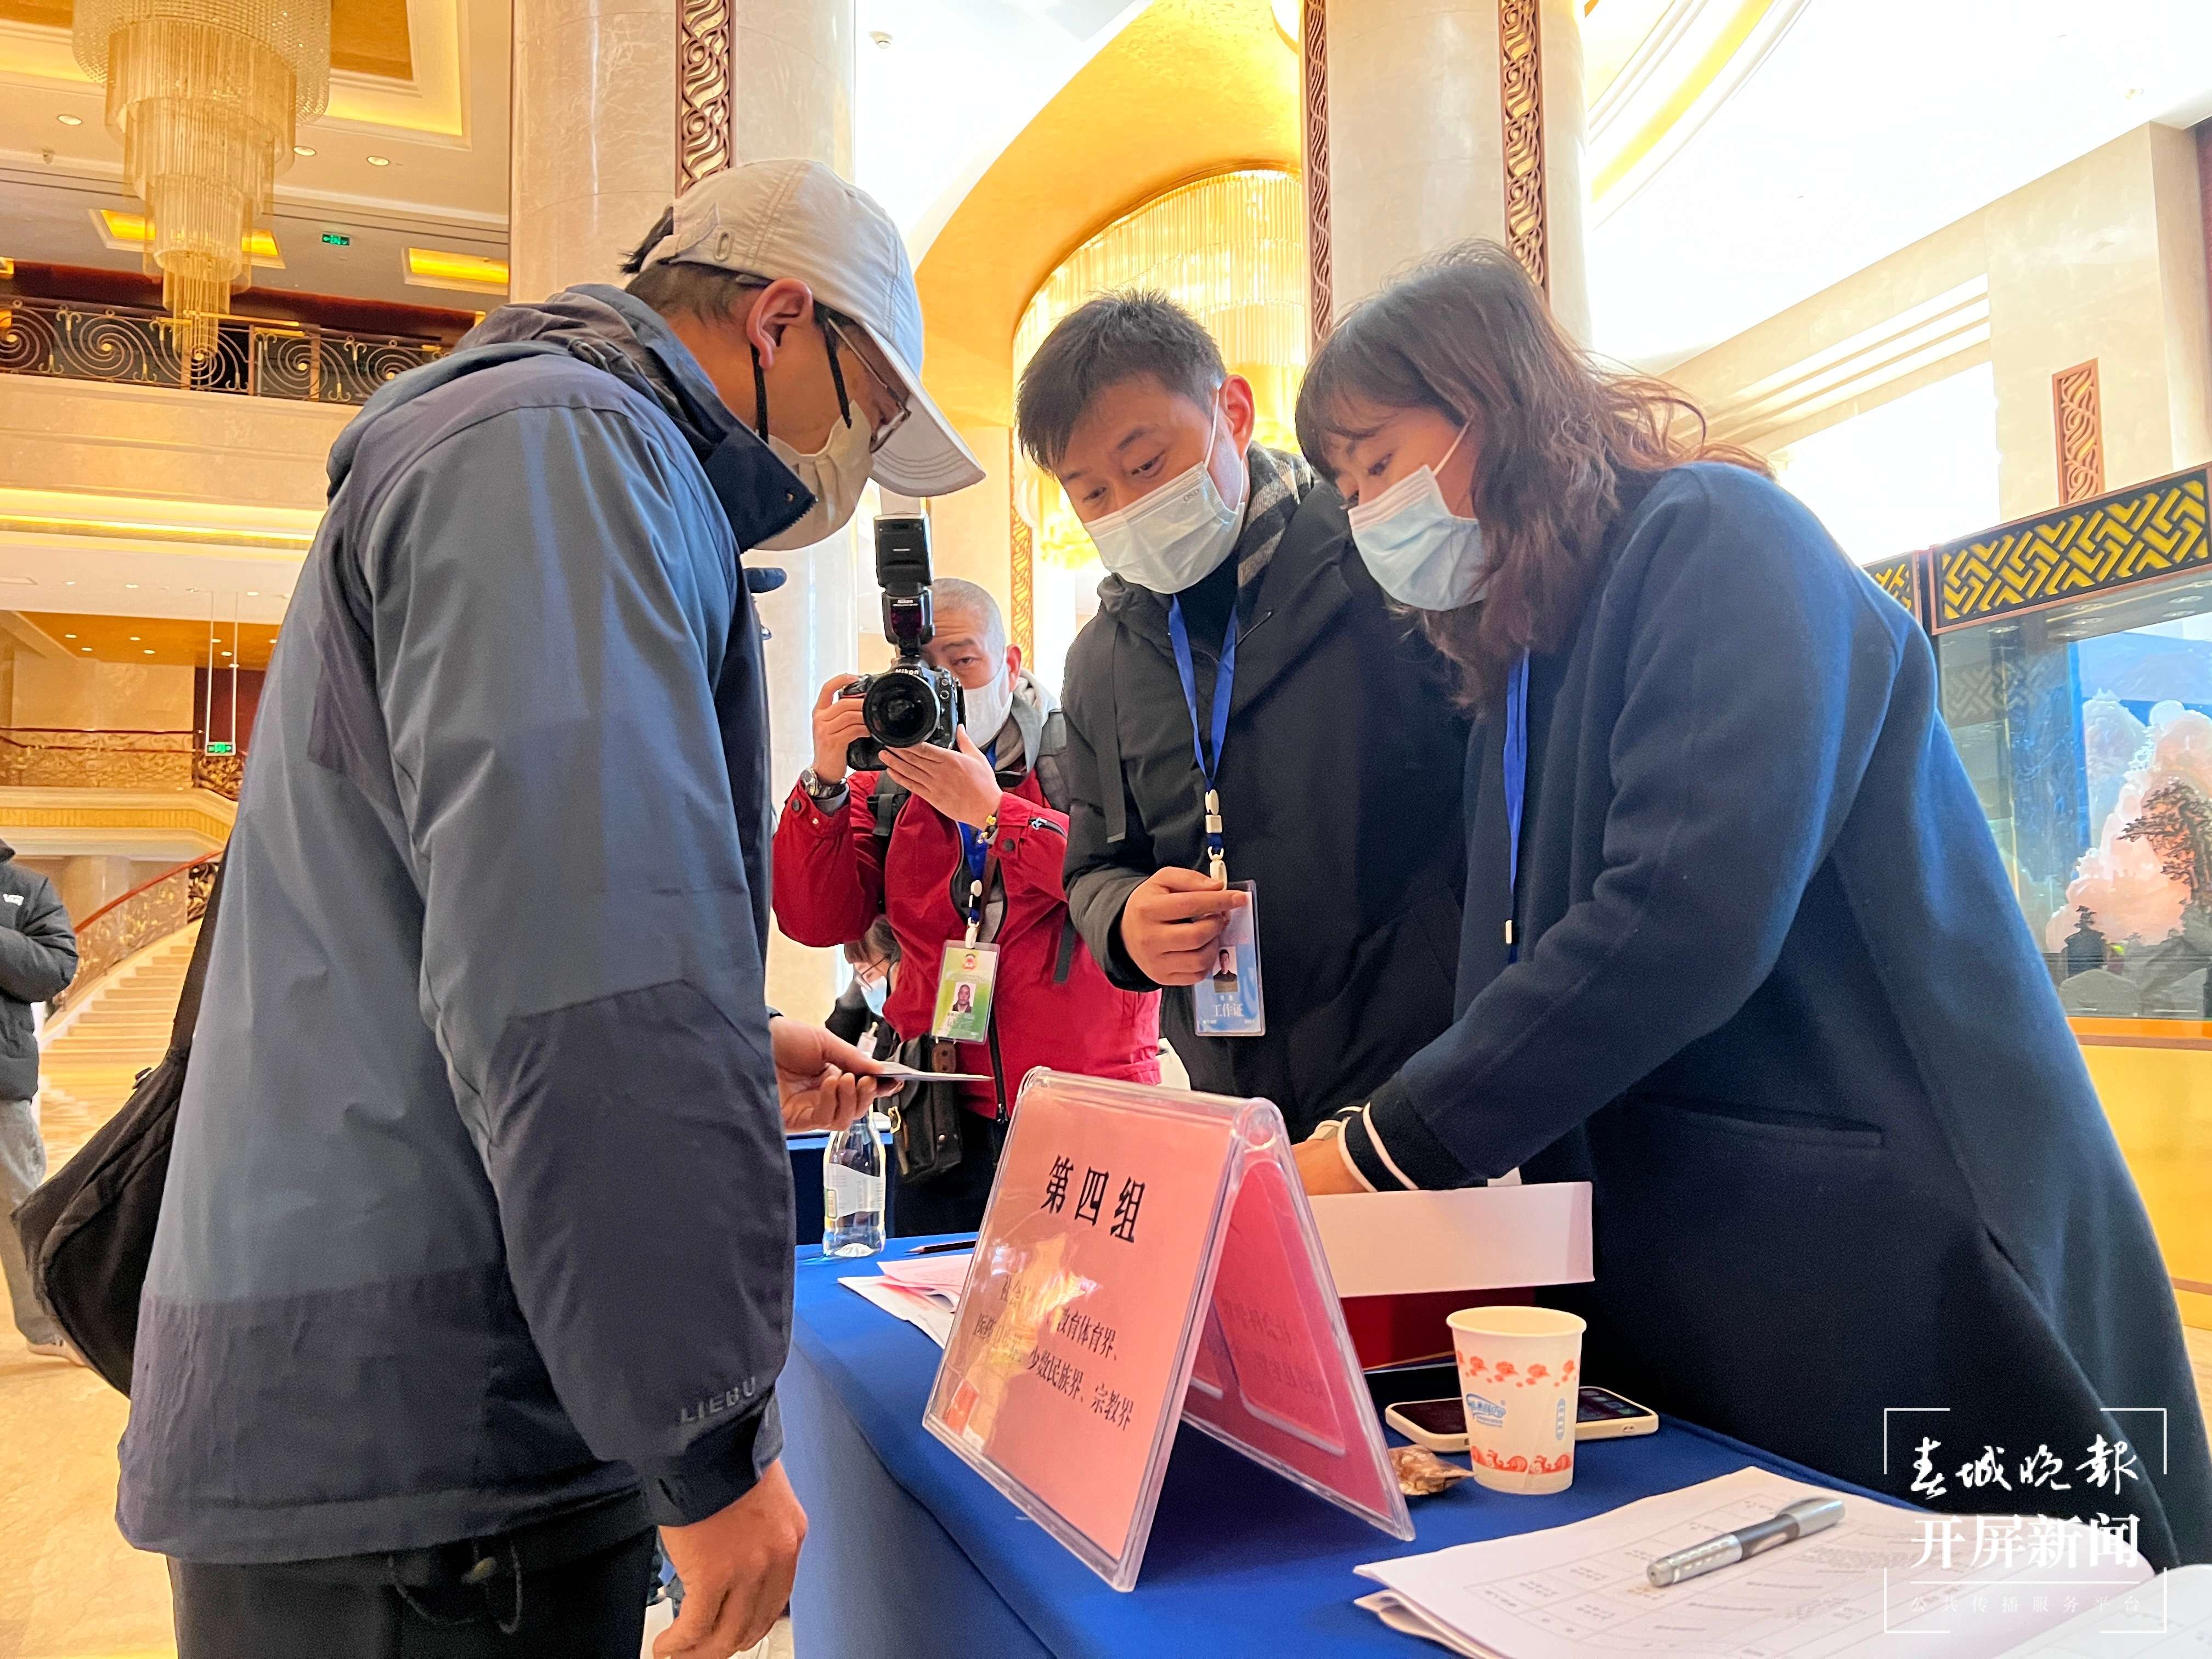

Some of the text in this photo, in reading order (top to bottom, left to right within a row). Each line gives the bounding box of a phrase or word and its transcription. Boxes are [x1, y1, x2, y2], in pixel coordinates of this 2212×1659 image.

[1214, 1003, 1244, 1017] 工作证
[1040, 1155, 1146, 1243] 第四组
